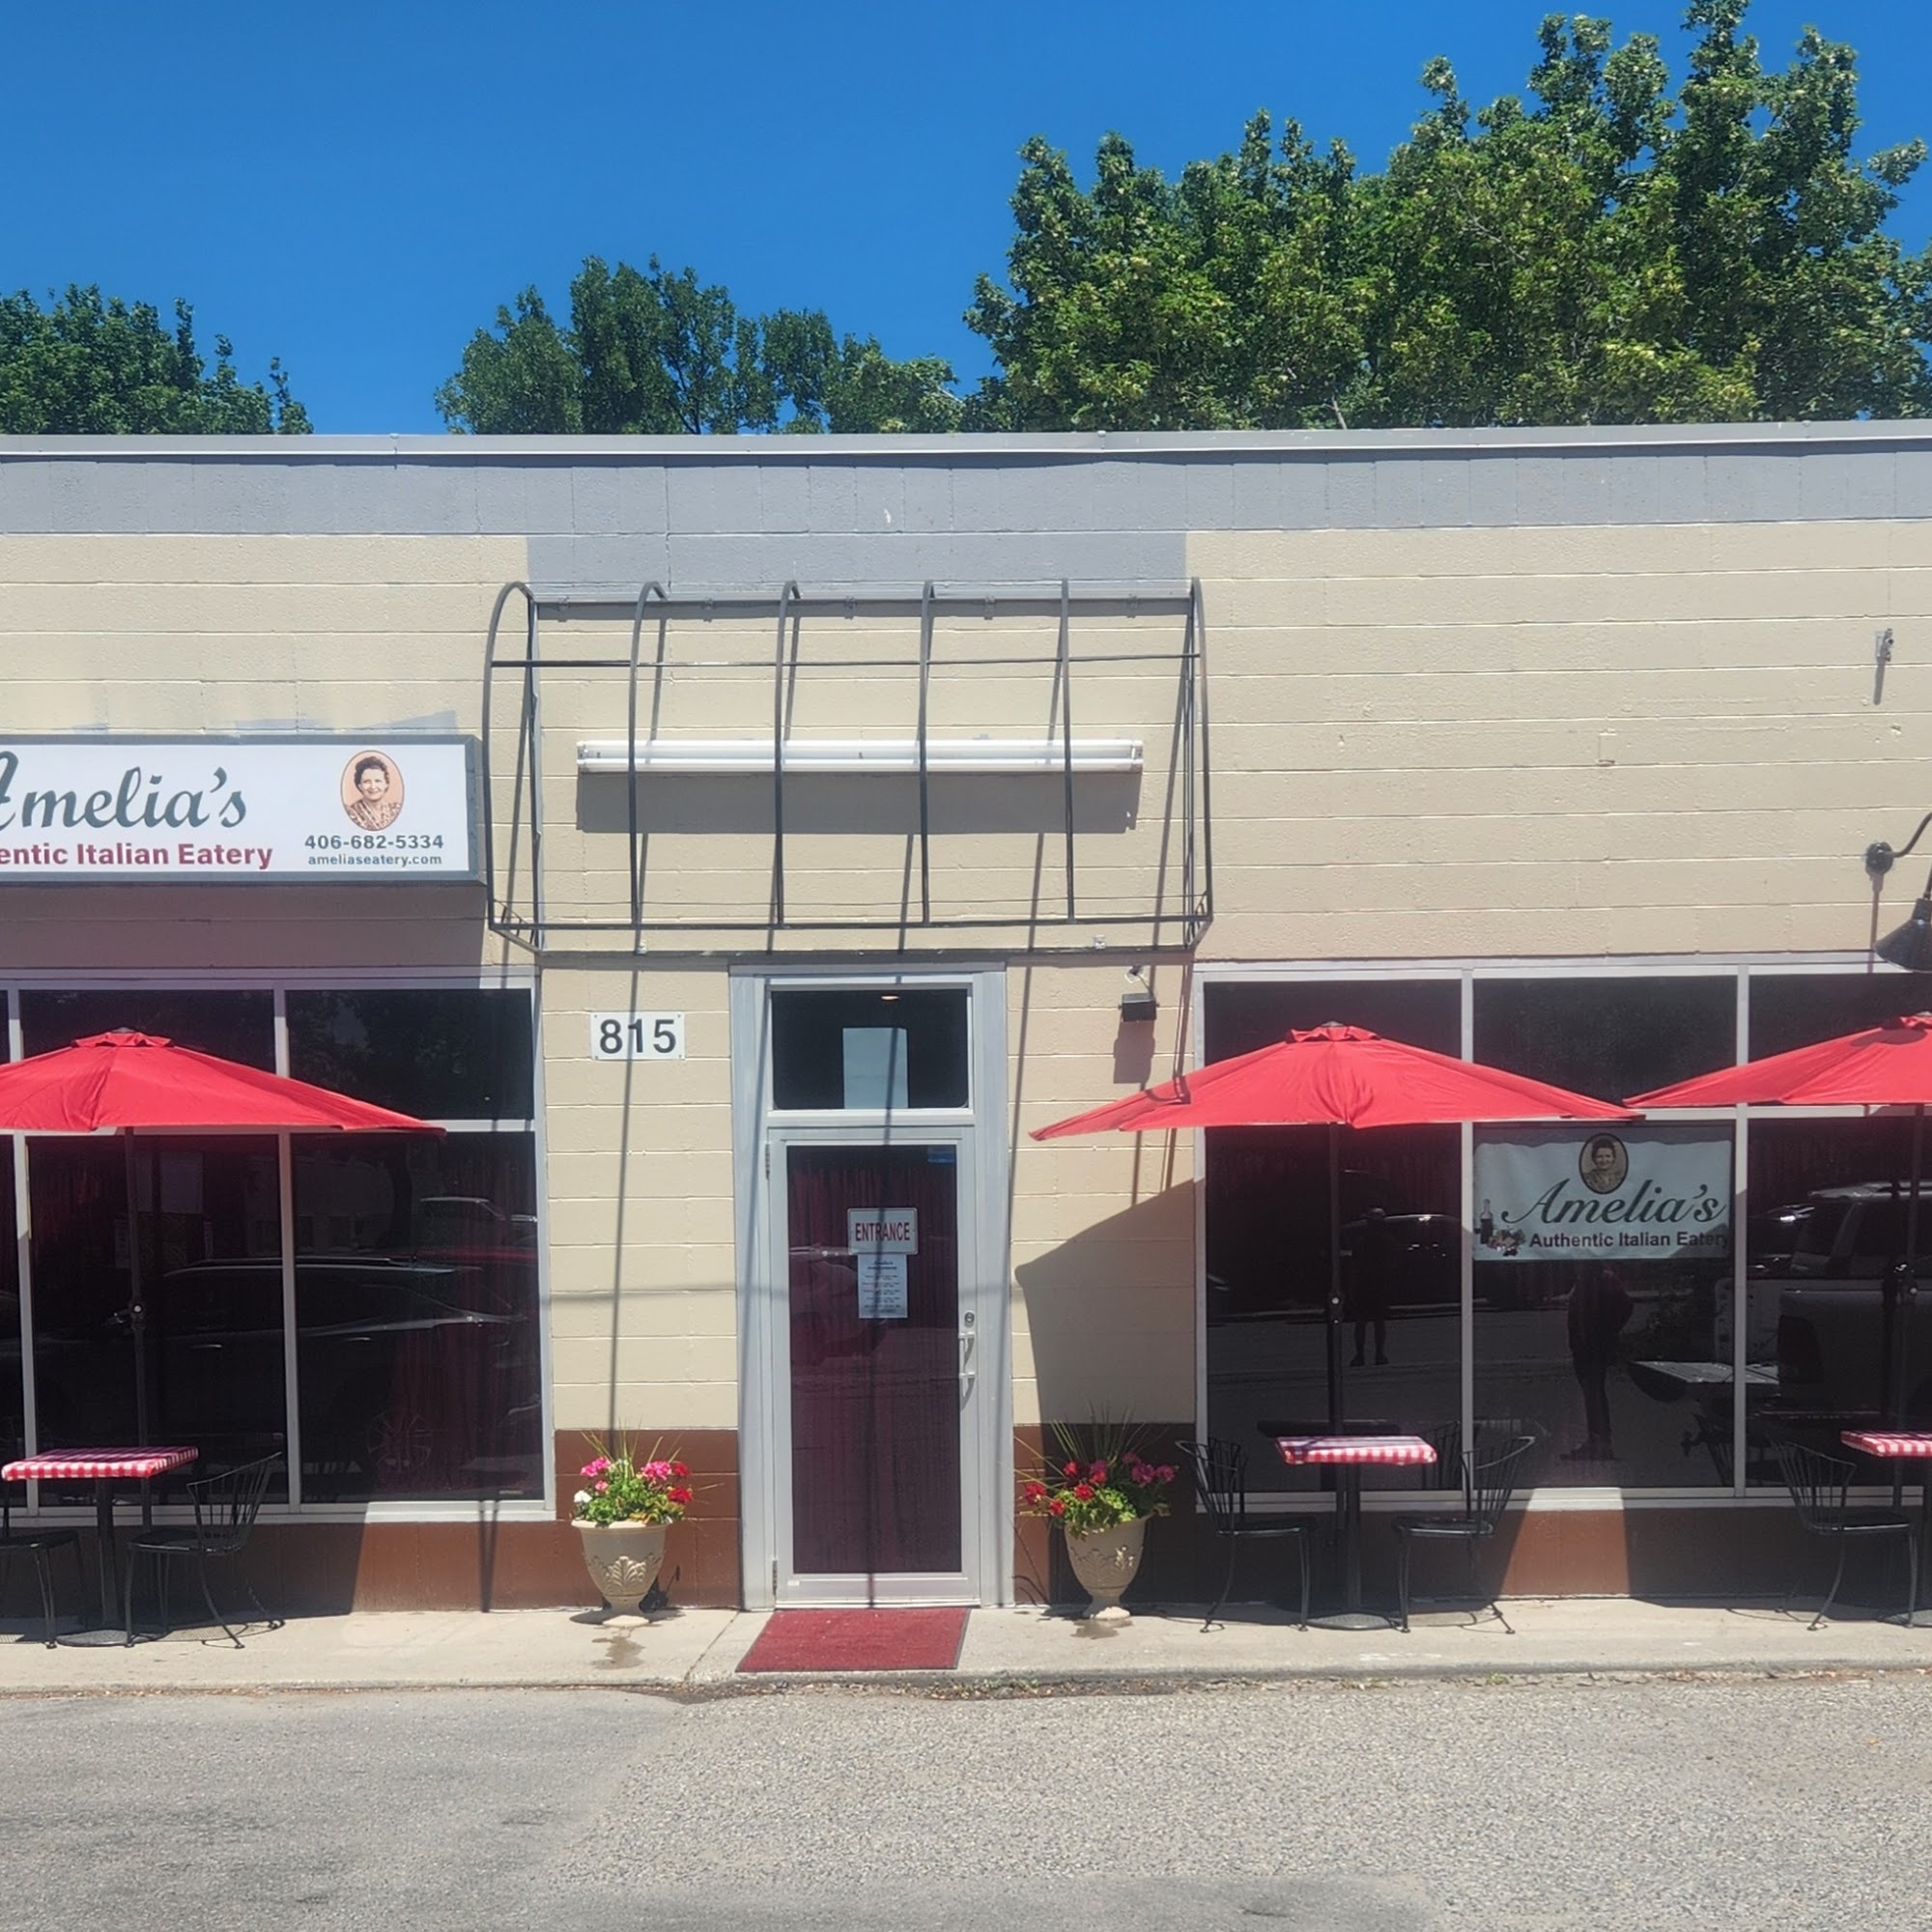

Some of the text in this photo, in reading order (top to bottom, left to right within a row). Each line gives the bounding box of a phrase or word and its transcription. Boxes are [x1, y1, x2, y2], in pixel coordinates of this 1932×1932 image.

[304, 835, 444, 850] 406-682-5334
[76, 842, 169, 865] Italian
[178, 843, 273, 870] Eatery
[308, 854, 442, 867] ameliaseatery.com
[600, 1018, 676, 1054] 815
[1501, 1178, 1726, 1224] Amelia's
[855, 1221, 910, 1241] ENTRANCE
[1529, 1232, 1614, 1248] Authentic
[1619, 1232, 1670, 1246] Italian
